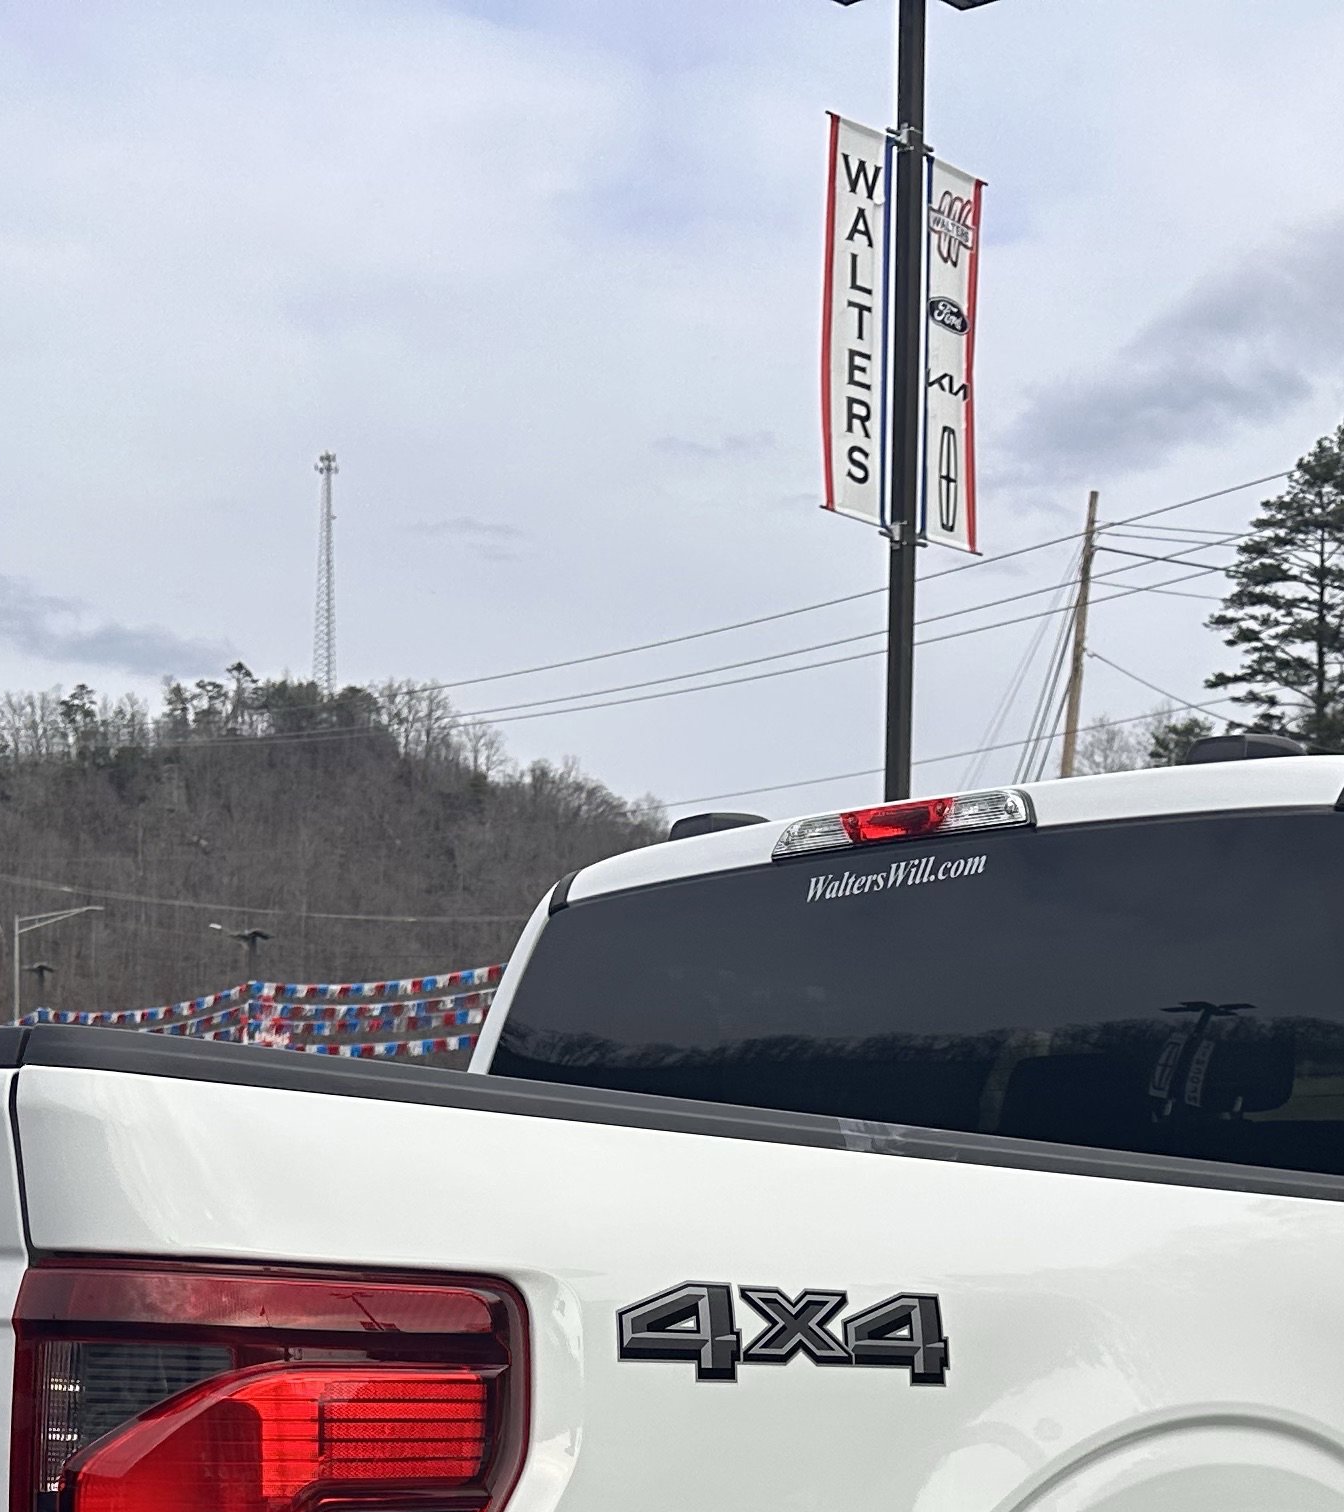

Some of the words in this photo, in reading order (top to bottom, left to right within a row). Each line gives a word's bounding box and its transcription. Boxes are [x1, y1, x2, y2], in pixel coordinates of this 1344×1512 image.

[931, 215, 970, 243] WALTERS
[841, 153, 883, 485] WALTERS
[933, 300, 964, 332] Ford
[806, 855, 988, 903] WaltersWill.com
